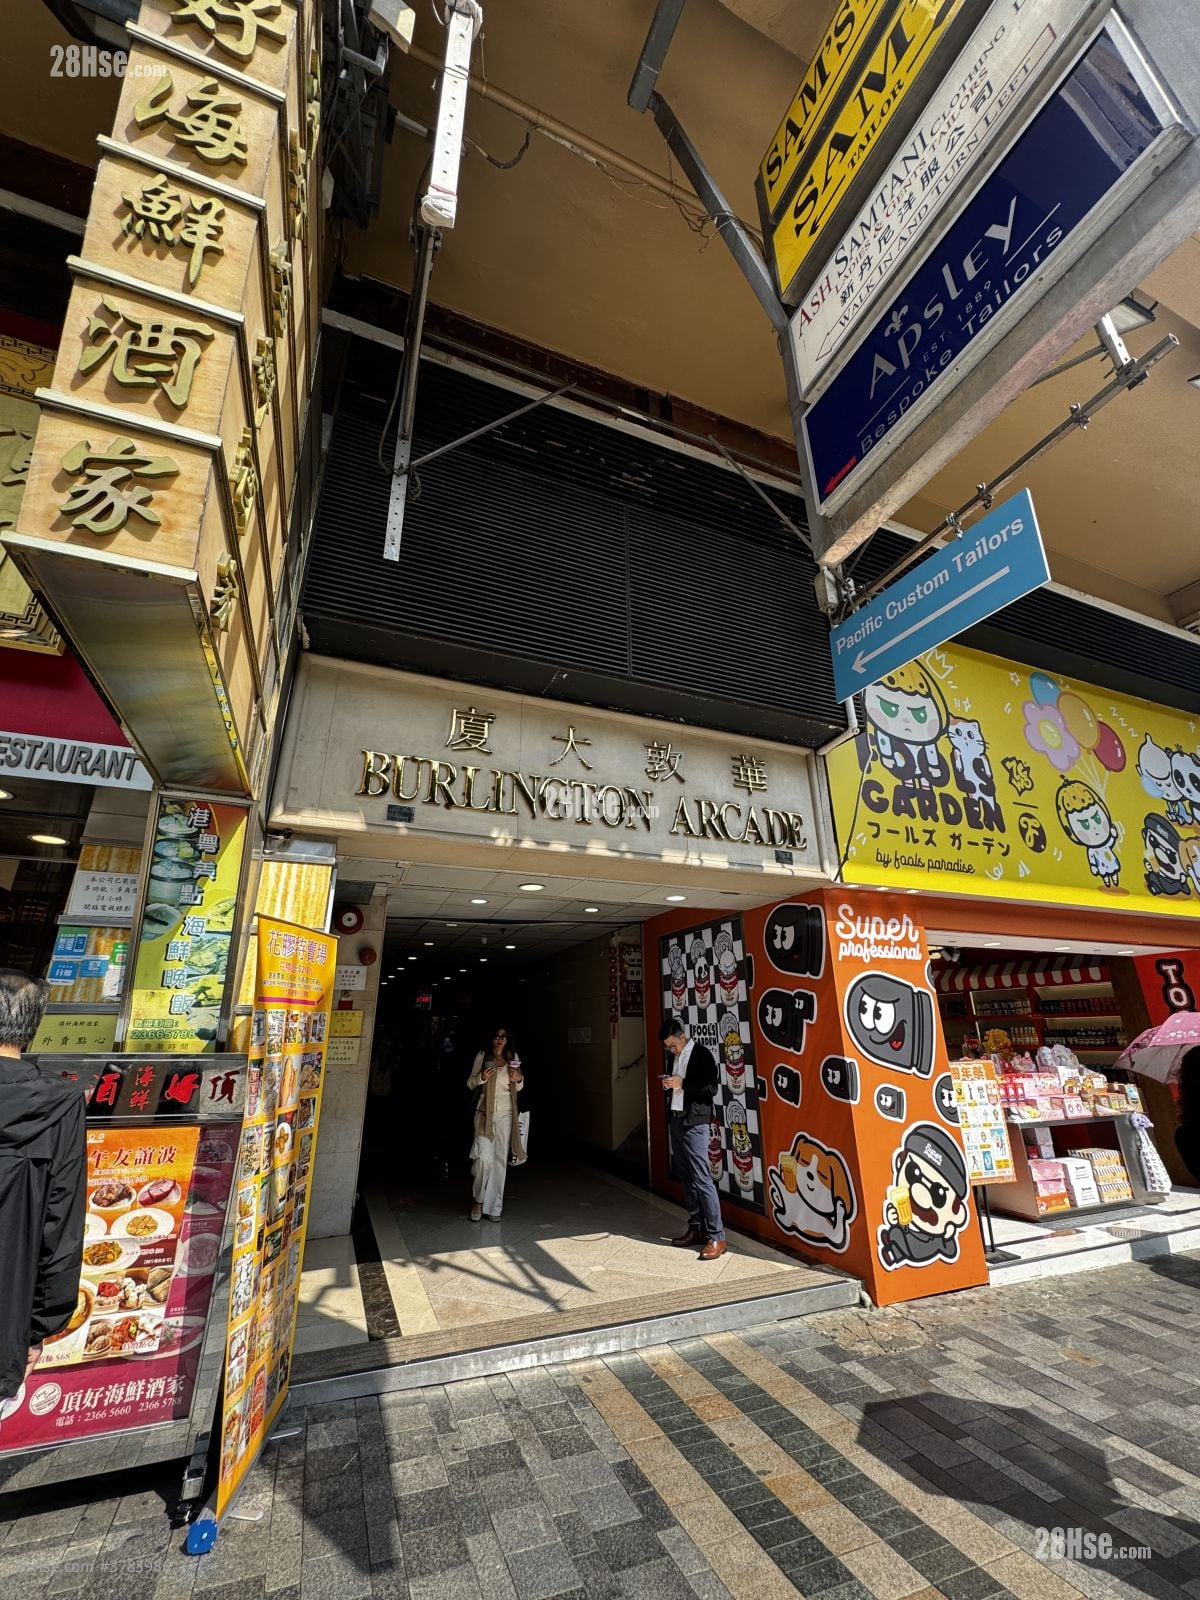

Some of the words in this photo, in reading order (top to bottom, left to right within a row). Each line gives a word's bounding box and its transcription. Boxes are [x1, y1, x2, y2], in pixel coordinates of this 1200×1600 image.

[847, 78, 905, 171] TAILOR
[799, 274, 834, 337] ASH
[834, 127, 930, 278] SAMTANI
[930, 24, 1006, 136] CLOTHING
[834, 240, 872, 294] LADIES
[873, 222, 884, 238] &
[885, 158, 927, 219] GENTS
[929, 67, 989, 152] TAILORS
[838, 281, 876, 329] WALK
[876, 252, 894, 276] IN
[897, 204, 929, 251] AND
[932, 132, 979, 197] TURN
[984, 57, 1031, 128] LEFT
[839, 80, 993, 307] 新丹尼洋服公司
[957, 280, 991, 322] 1889
[861, 349, 952, 454] Bespoke
[961, 224, 1063, 336] Tailors
[836, 614, 883, 655] Pacific
[885, 567, 949, 620] Custom
[952, 517, 1024, 574] Tailors
[355, 748, 655, 832] BURLINGTON
[669, 795, 808, 850] ARCADE
[861, 779, 1006, 834] GARDEN
[867, 821, 937, 848] フールズ
[949, 832, 1011, 857] ガーデン
[876, 848, 892, 869] by
[927, 854, 976, 874] paradise
[835, 903, 920, 945] Super
[838, 939, 923, 963] professional
[162, 916, 207, 1016] 海鮮晚飯
[130, 1029, 196, 1040] 23665788
[59, 1374, 187, 1414] 頂好海鮮酒家
[84, 1411, 107, 1422] 2366
[108, 1405, 132, 1417] 5660
[138, 1400, 160, 1413] 2366
